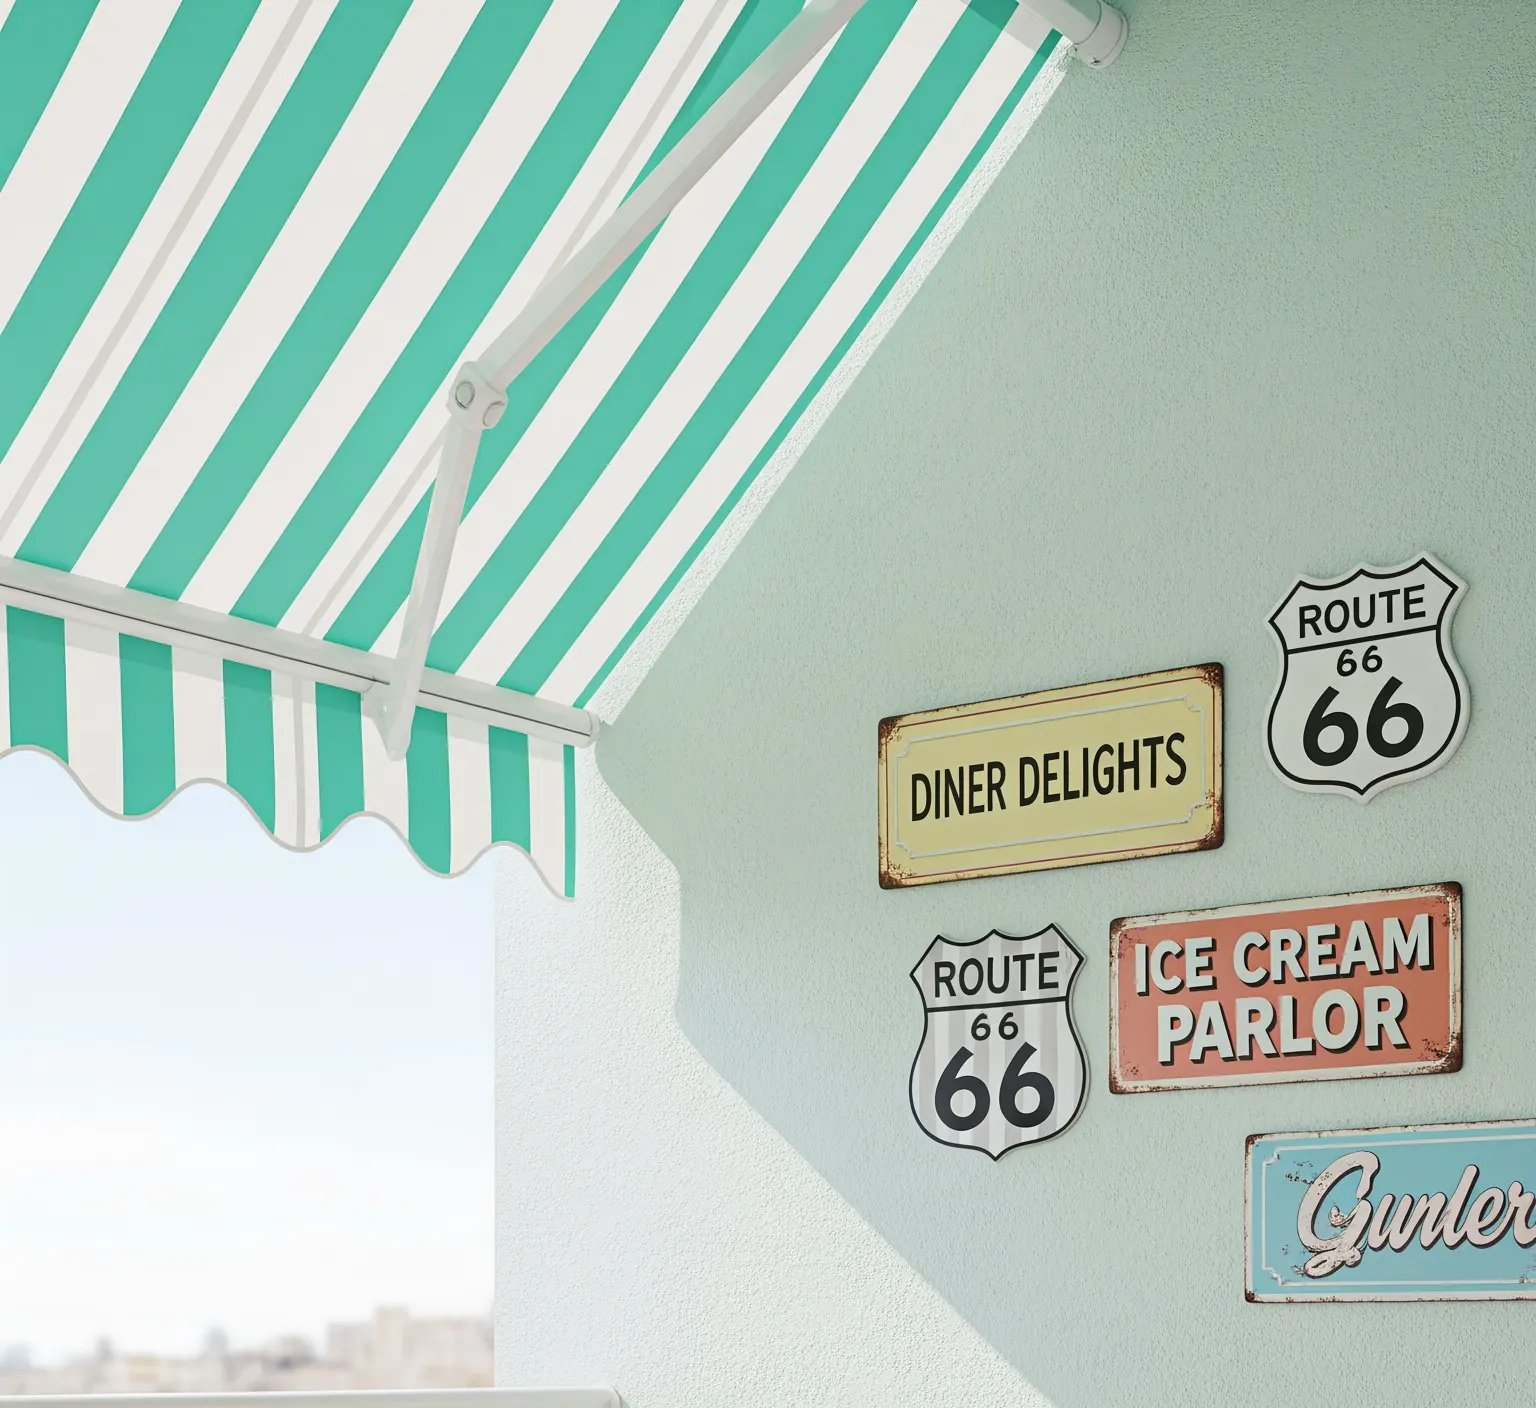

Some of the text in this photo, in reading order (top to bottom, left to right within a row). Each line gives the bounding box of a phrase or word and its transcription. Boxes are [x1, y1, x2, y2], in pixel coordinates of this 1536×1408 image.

[1299, 583, 1426, 638] ROUTE
[1336, 645, 1383, 676] 66
[1303, 676, 1424, 766] 66
[911, 732, 1187, 822] DINER DELIGHTS
[934, 951, 1060, 998] ROUTE
[1134, 913, 1434, 996] ICE CREAM
[970, 1011, 1019, 1042] 66
[1157, 985, 1410, 1067] PARLOR
[934, 1041, 1056, 1132] 66
